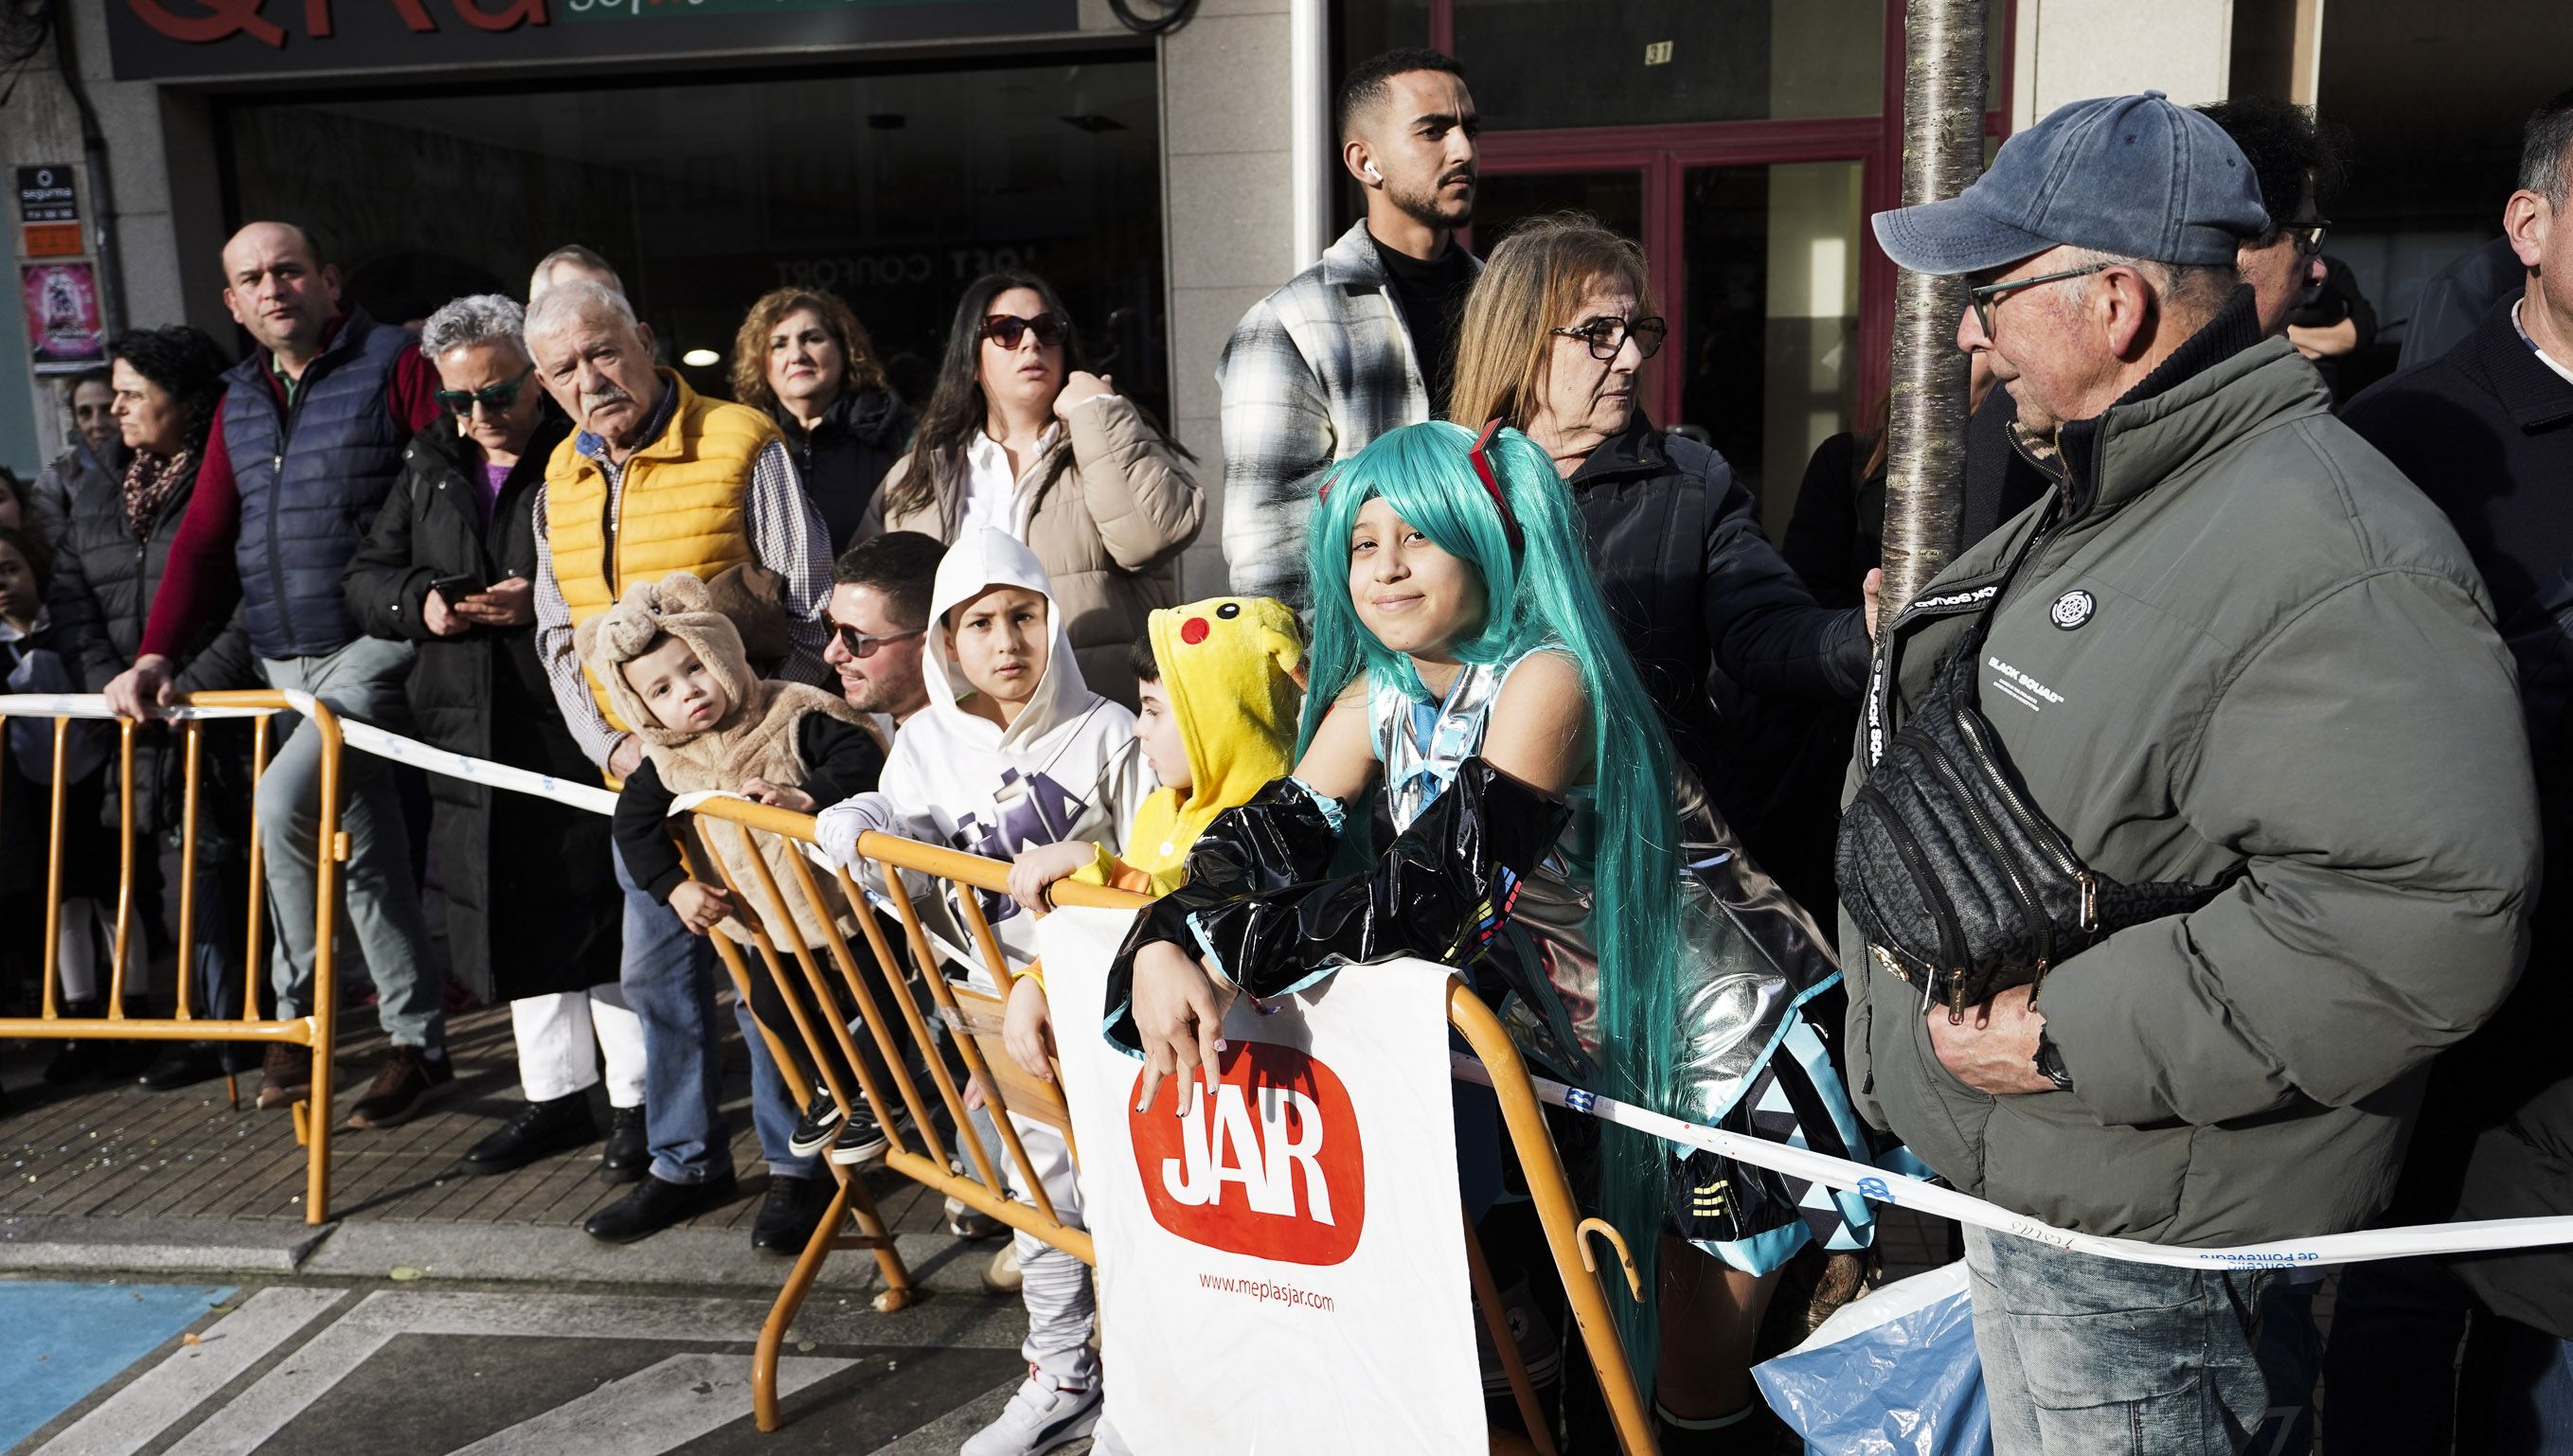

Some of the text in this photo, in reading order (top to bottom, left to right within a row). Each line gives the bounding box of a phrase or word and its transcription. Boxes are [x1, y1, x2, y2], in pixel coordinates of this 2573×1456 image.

[1650, 44, 1670, 62] 31
[1989, 656, 2021, 681] BLACK
[1868, 674, 1882, 727] BLACK
[1162, 1081, 1336, 1227] JAR
[1199, 1272, 1335, 1312] www.meplasjar.com
